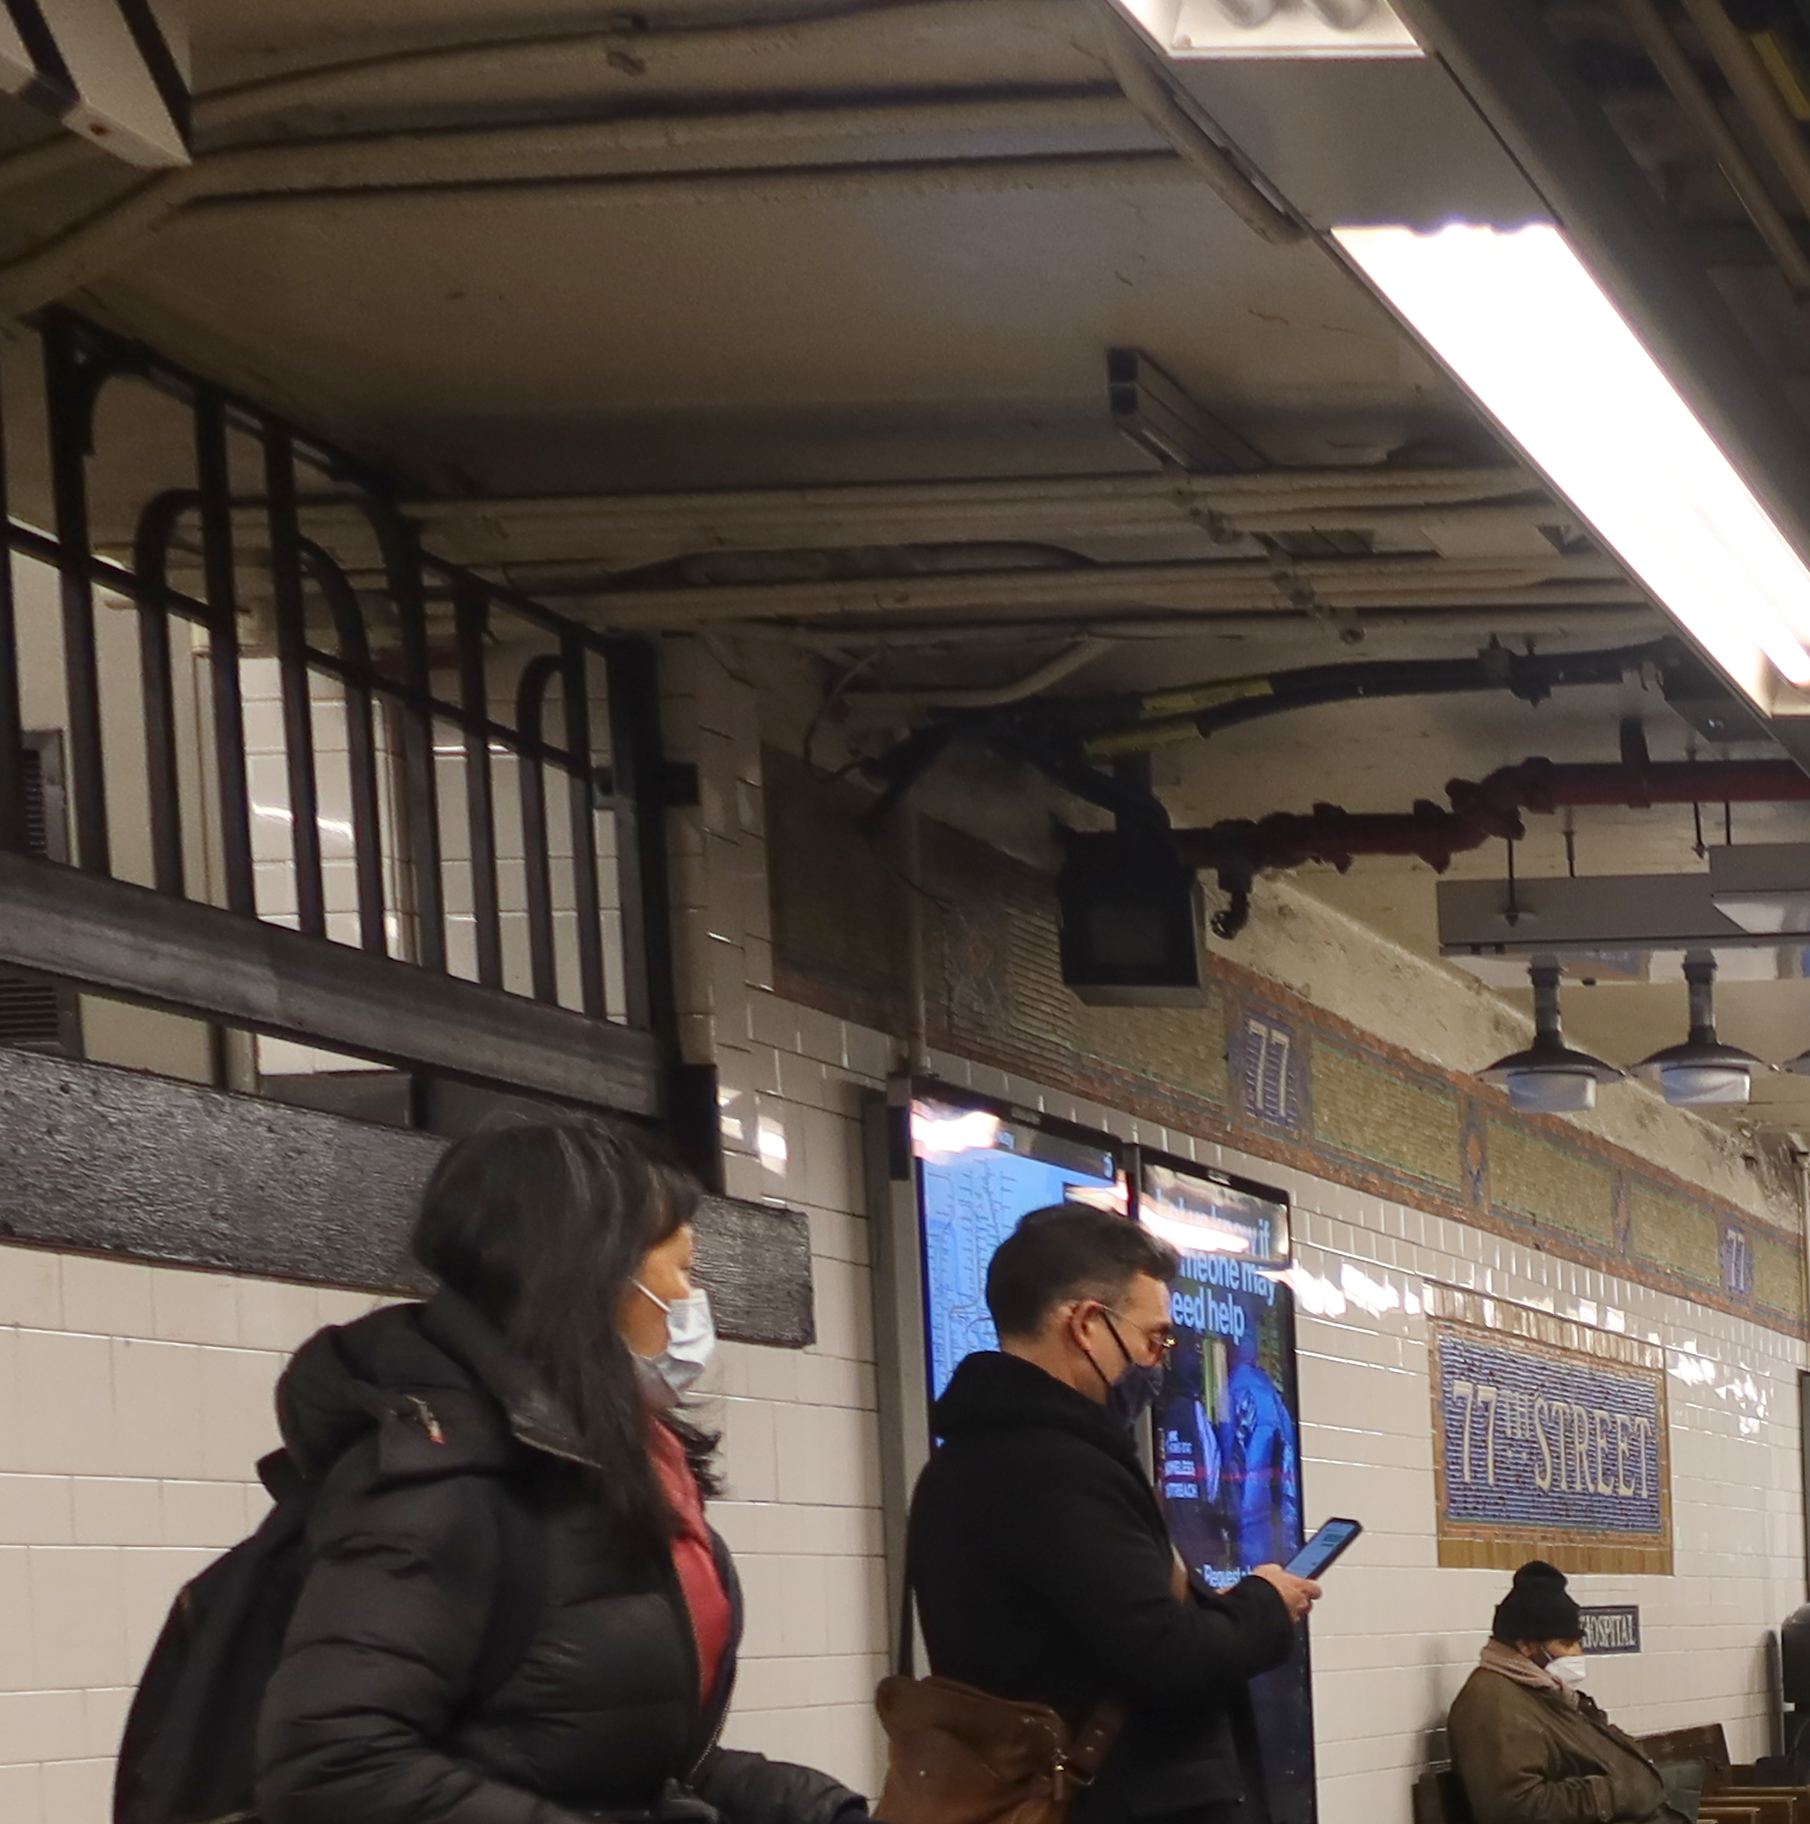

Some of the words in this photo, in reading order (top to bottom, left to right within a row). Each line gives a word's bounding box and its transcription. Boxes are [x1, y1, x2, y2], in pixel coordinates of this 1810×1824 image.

[1249, 1019, 1290, 1117] 77
[1727, 1229, 1746, 1290] 77
[1171, 1286, 1205, 1331] eed
[1207, 1290, 1246, 1345] help
[1532, 1396, 1653, 1499] STREET
